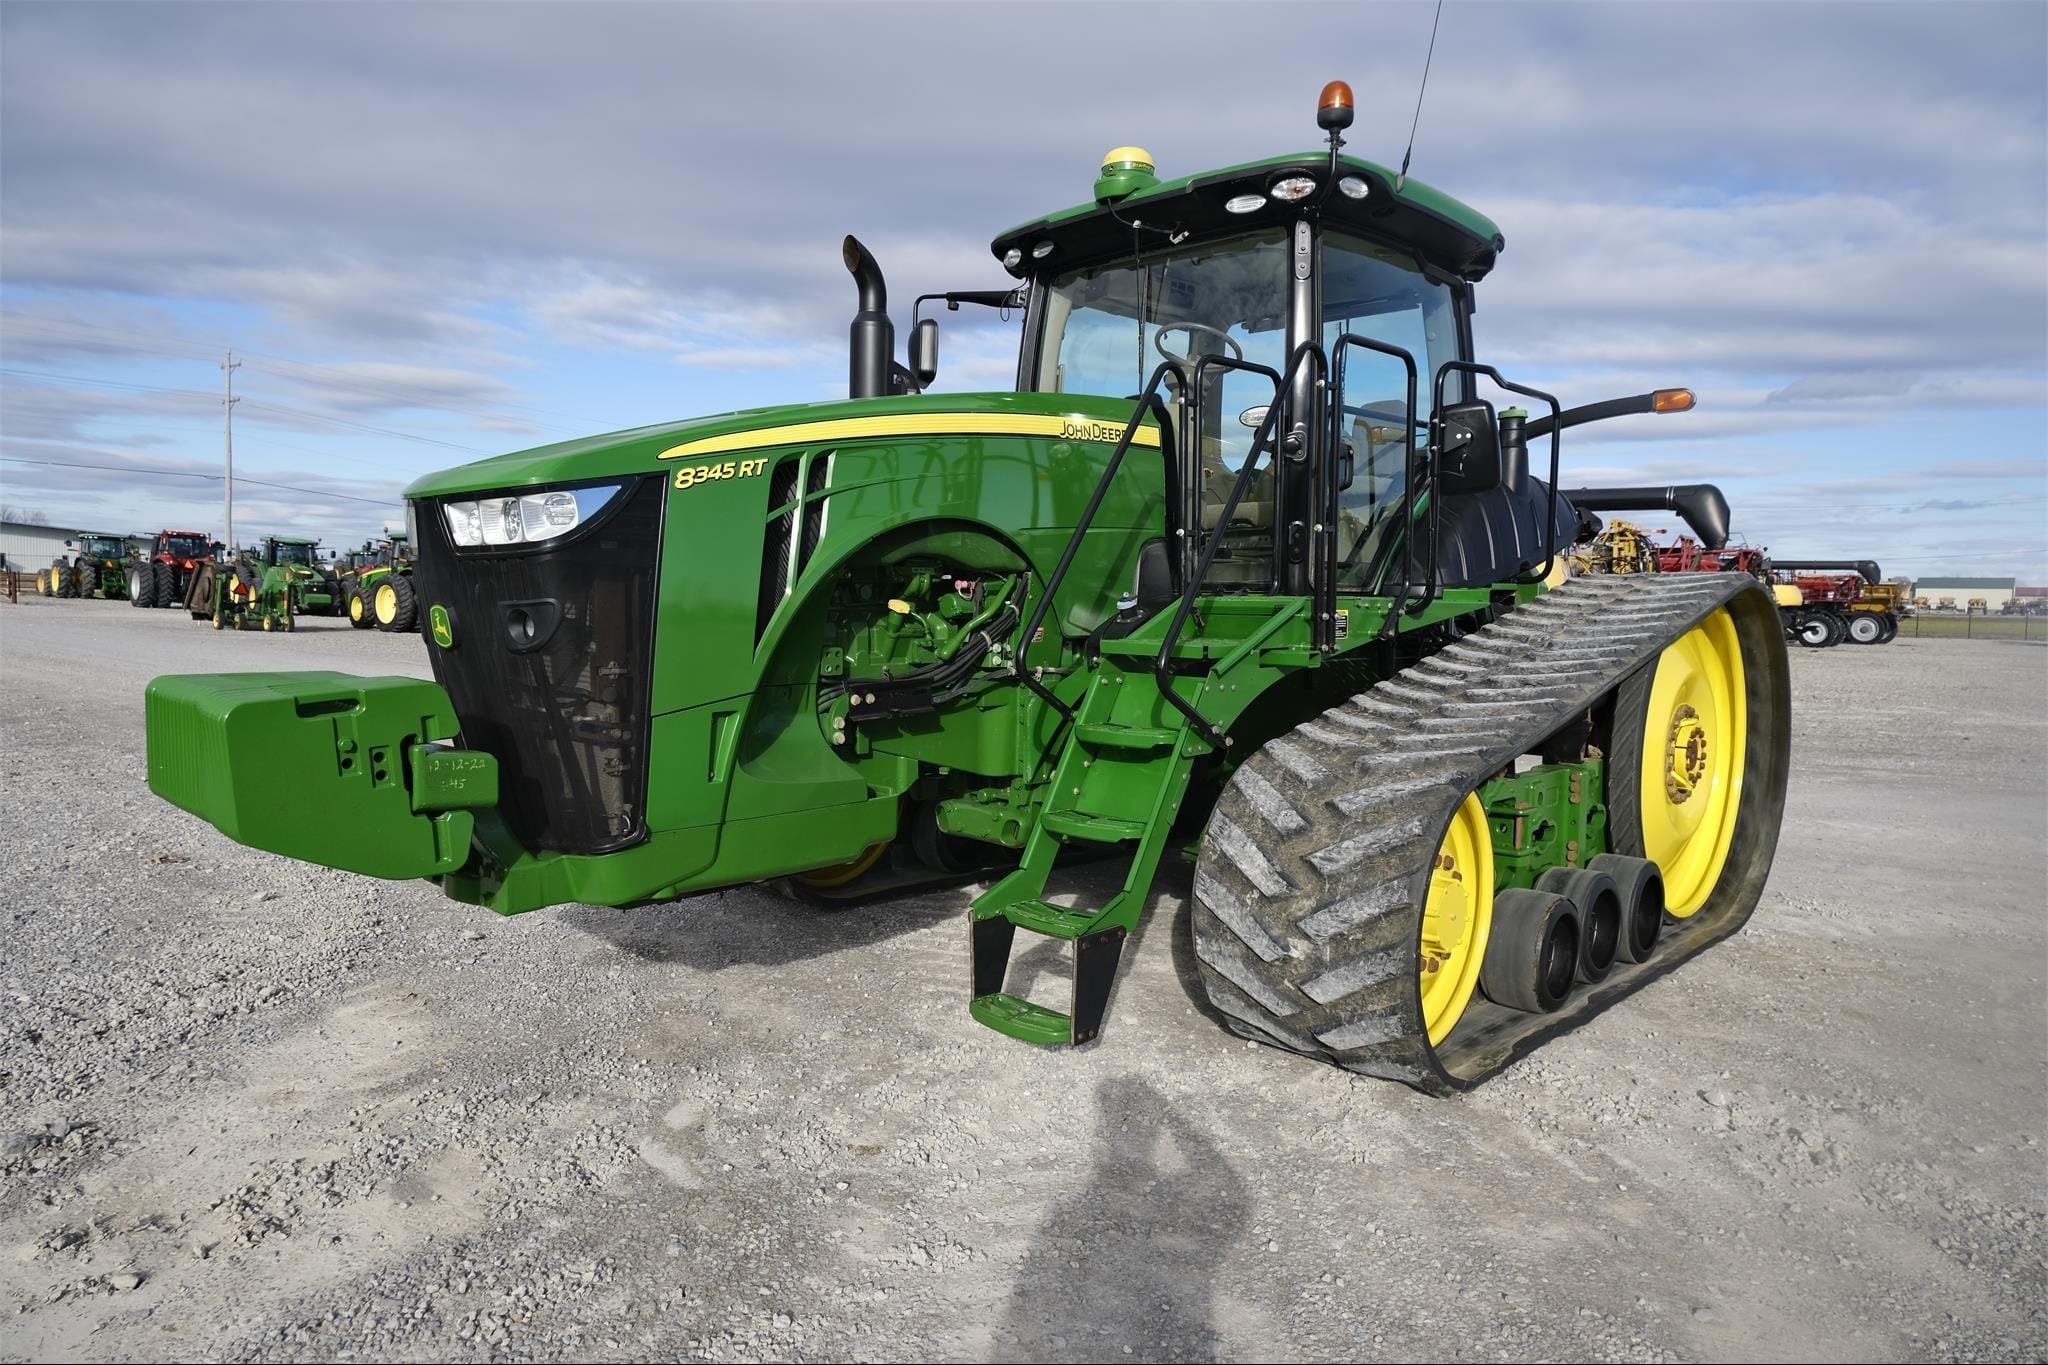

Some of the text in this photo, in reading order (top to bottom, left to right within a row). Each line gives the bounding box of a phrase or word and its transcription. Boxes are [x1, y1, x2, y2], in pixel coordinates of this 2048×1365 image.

[1060, 420, 1091, 438] JOHN
[674, 458, 769, 490] 8345 RT
